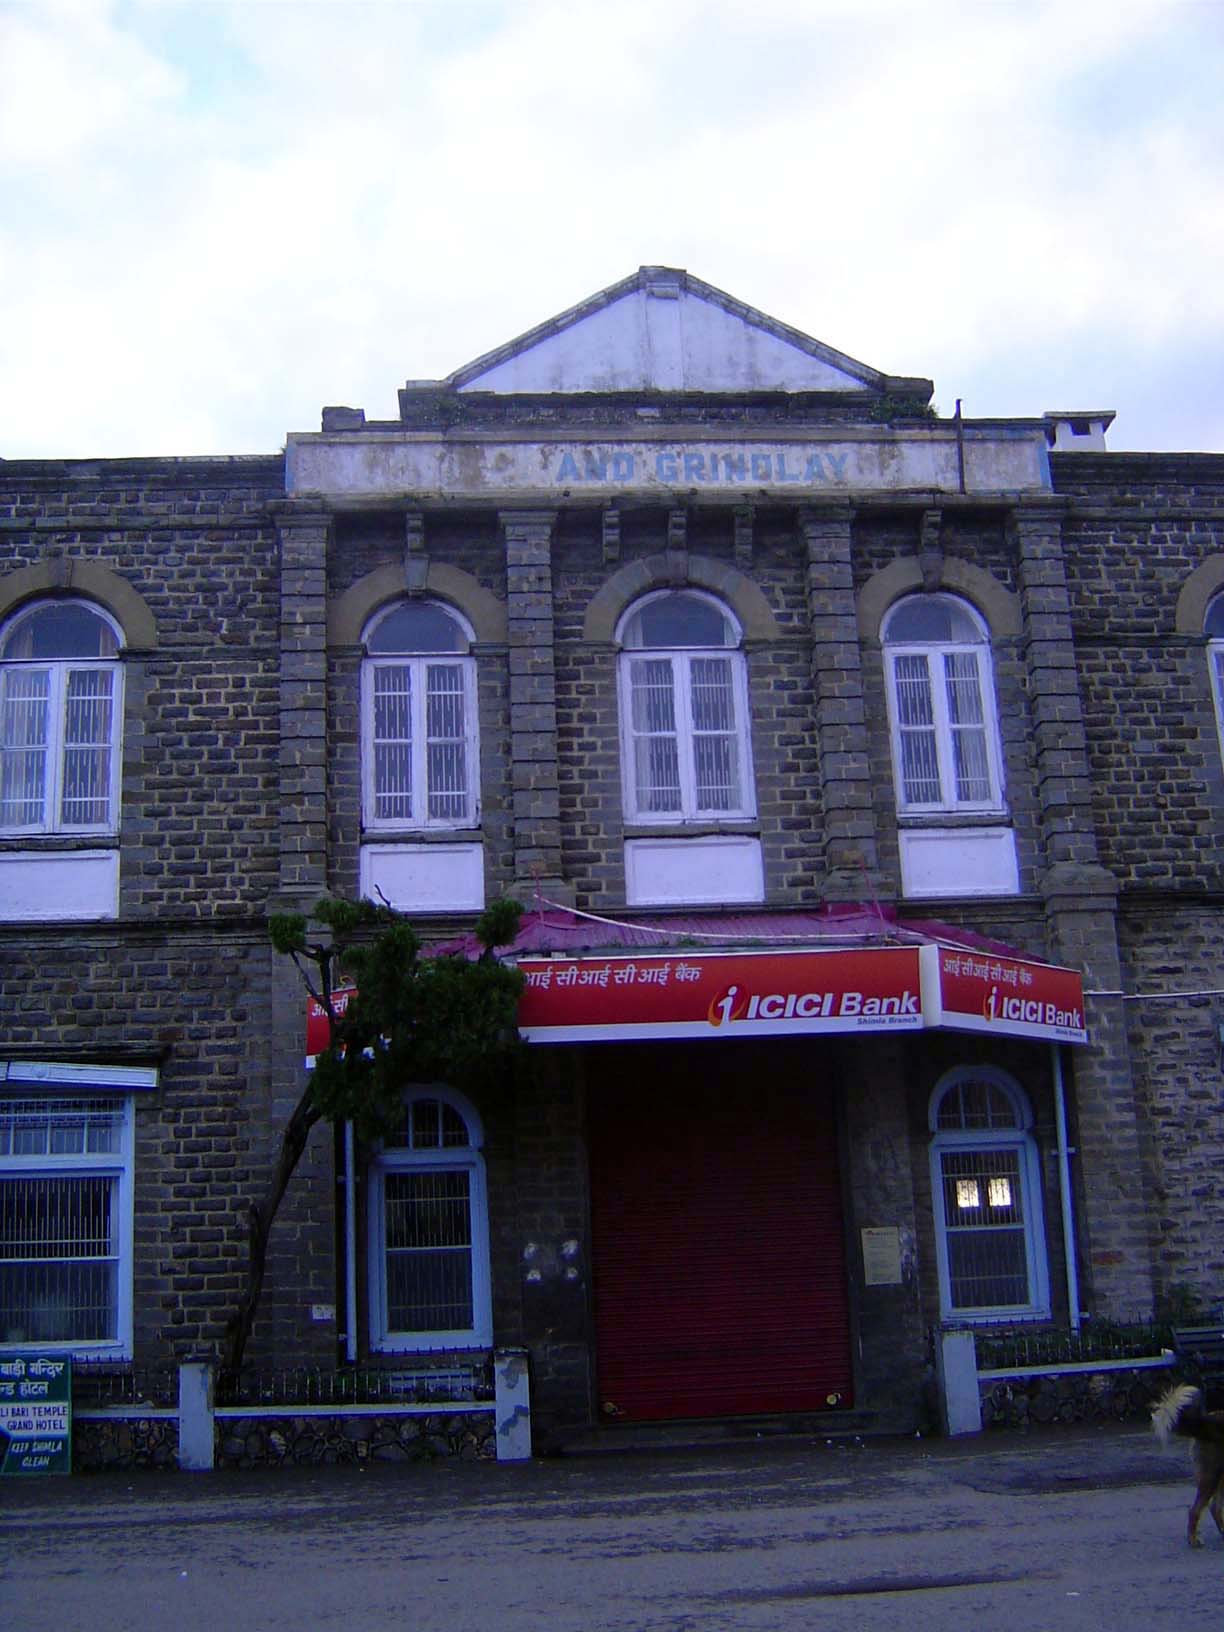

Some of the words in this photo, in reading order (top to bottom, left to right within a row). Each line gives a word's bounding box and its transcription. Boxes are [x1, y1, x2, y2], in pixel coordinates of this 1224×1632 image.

[556, 452, 633, 481] AND
[656, 452, 848, 482] GRINDLAY
[747, 992, 834, 1019] ICICI
[839, 990, 919, 1016] Bank
[1002, 996, 1043, 1024] ICICI
[1045, 1003, 1081, 1028] Bank
[888, 1016, 918, 1025] Branch
[32, 1406, 68, 1417] TEMPLE
[7, 1420, 33, 1432] GRAND
[36, 1419, 66, 1431] HOTEL
[22, 1456, 50, 1467] CLEAN
